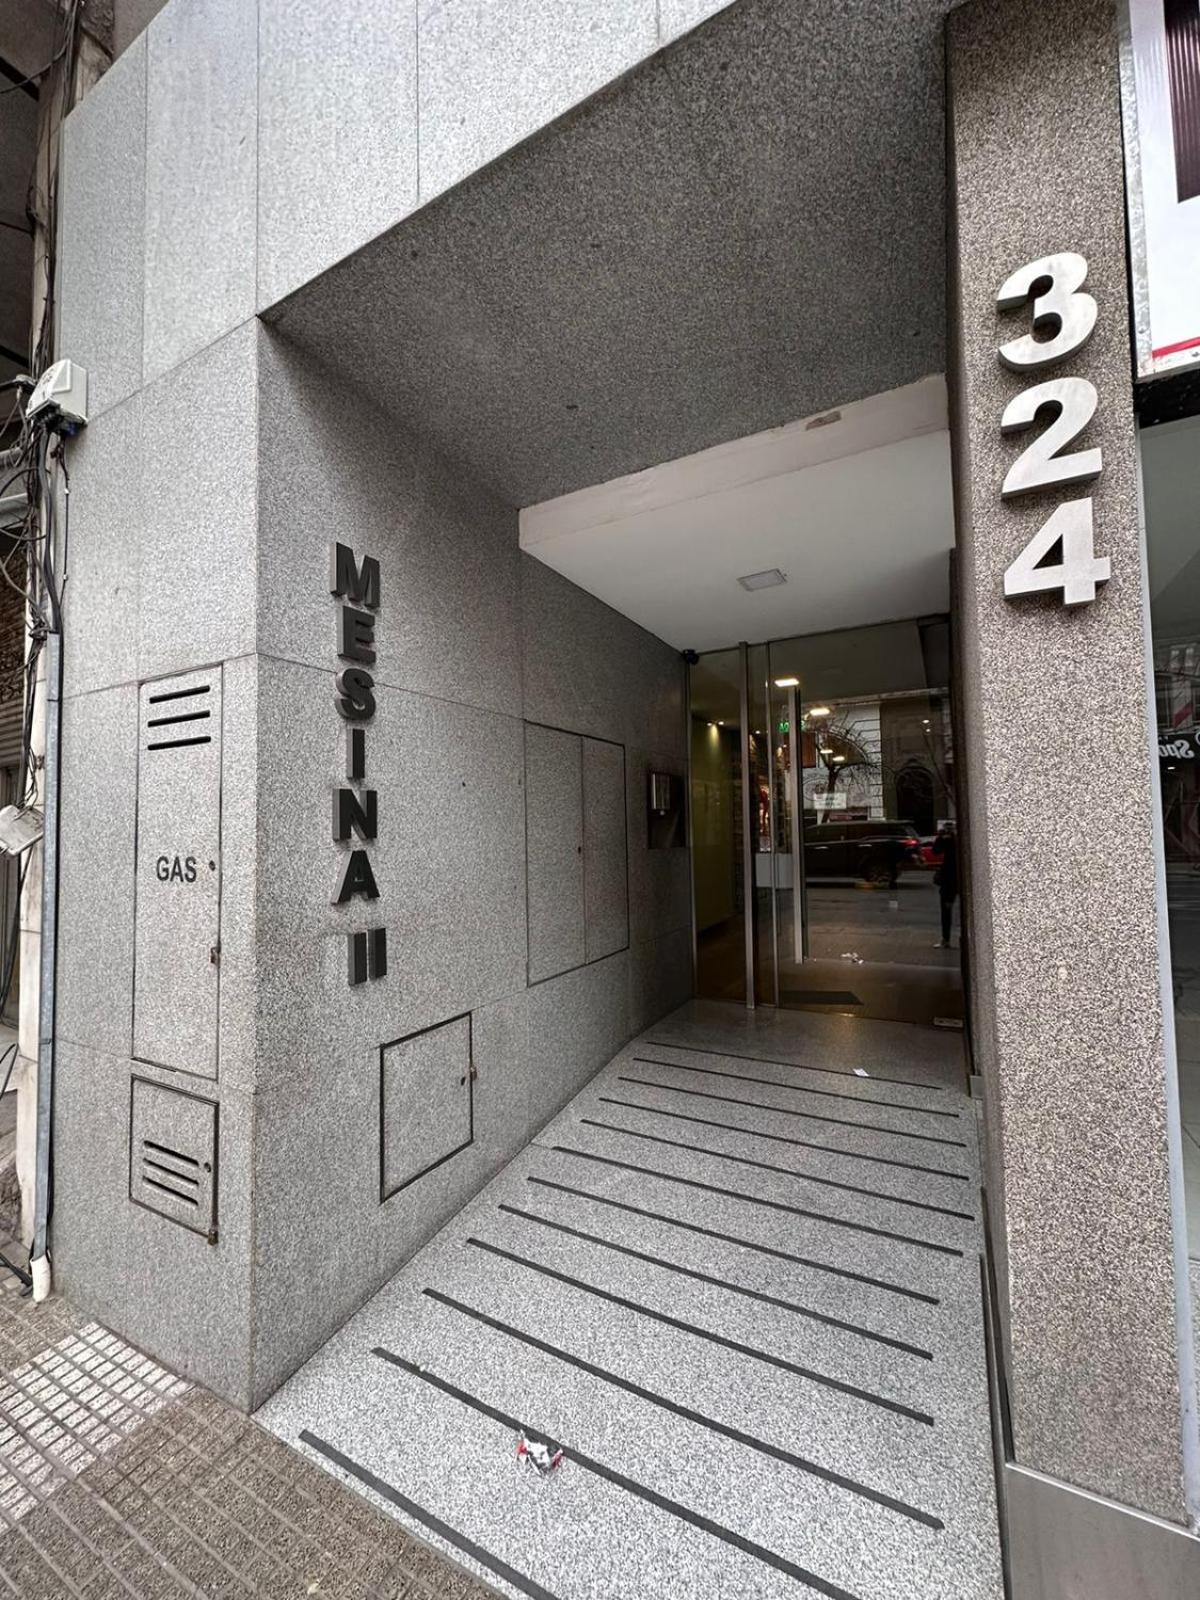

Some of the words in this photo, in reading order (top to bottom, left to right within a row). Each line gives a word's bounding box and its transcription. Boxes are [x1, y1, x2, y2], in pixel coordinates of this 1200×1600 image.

[997, 252, 1111, 604] 324
[156, 856, 197, 883] GAS
[331, 542, 381, 904] MESINA
